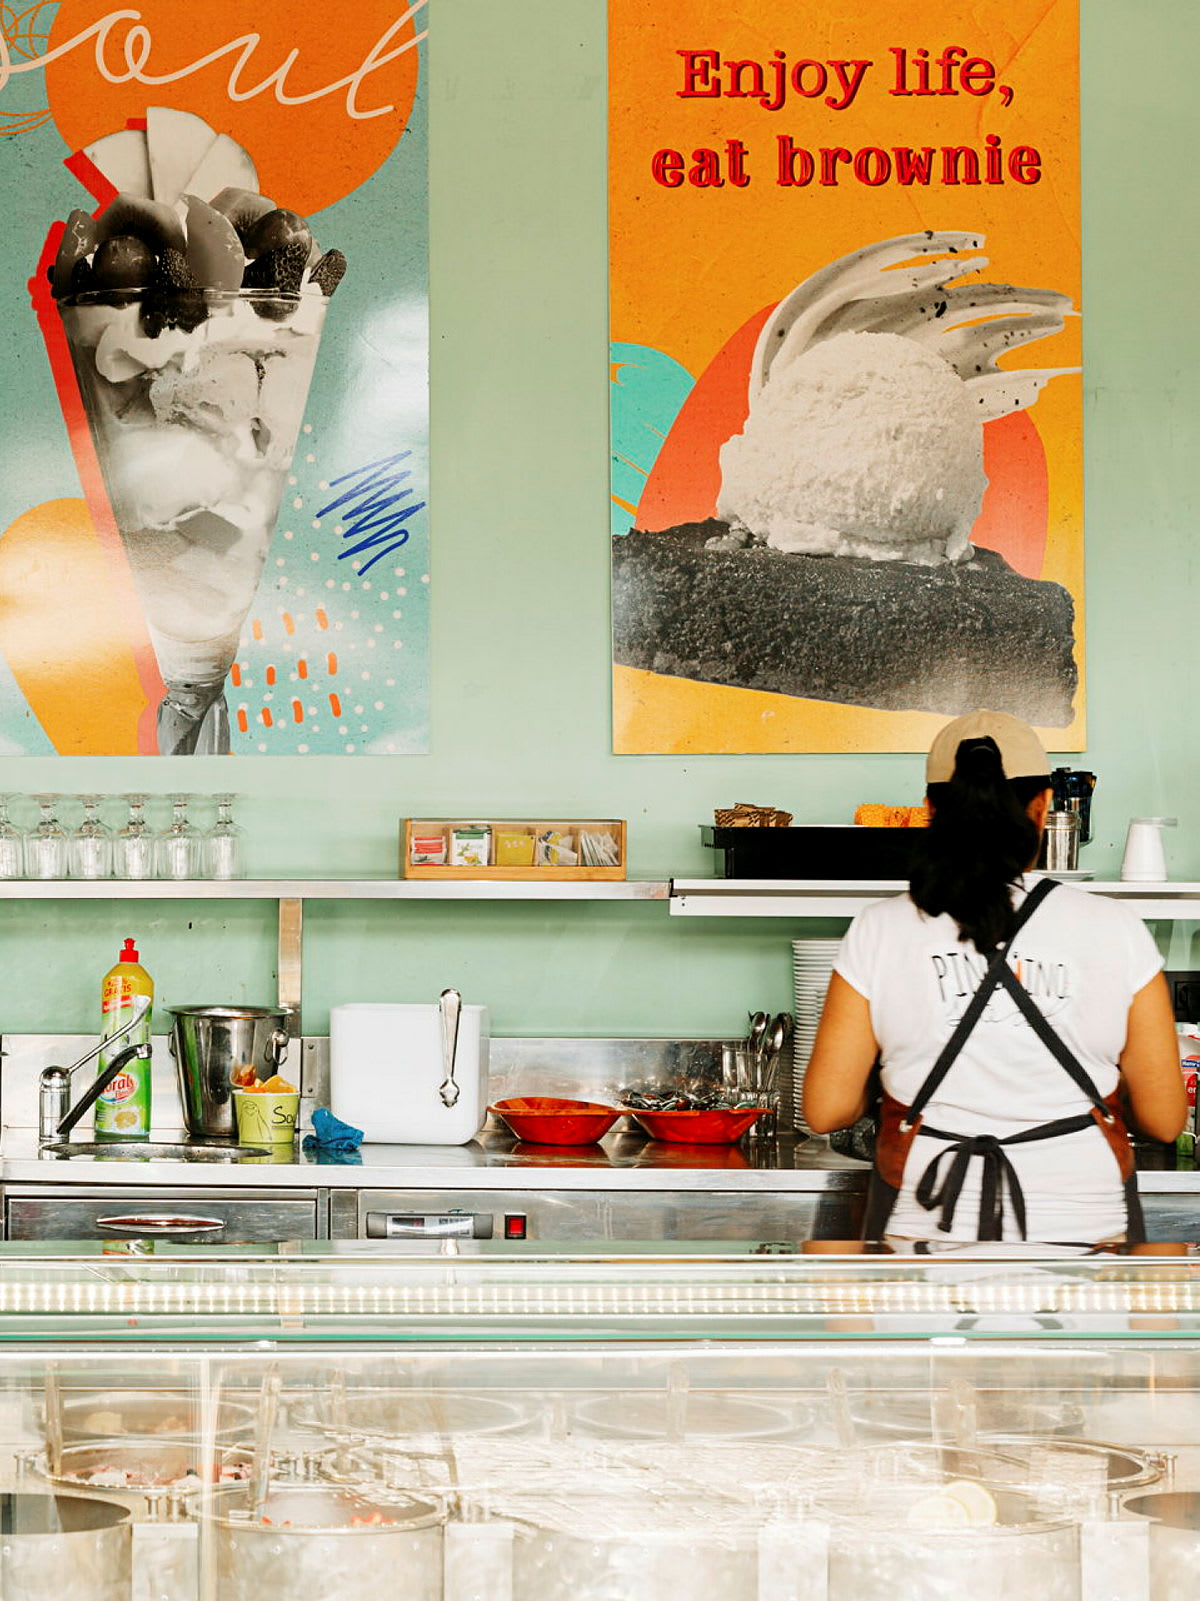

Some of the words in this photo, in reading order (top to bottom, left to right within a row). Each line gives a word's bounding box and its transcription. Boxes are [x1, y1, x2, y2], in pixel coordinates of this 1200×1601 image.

[675, 49, 873, 111] Enjoy
[888, 45, 1014, 107] life,
[650, 138, 751, 188] eat
[775, 133, 1042, 188] brownie
